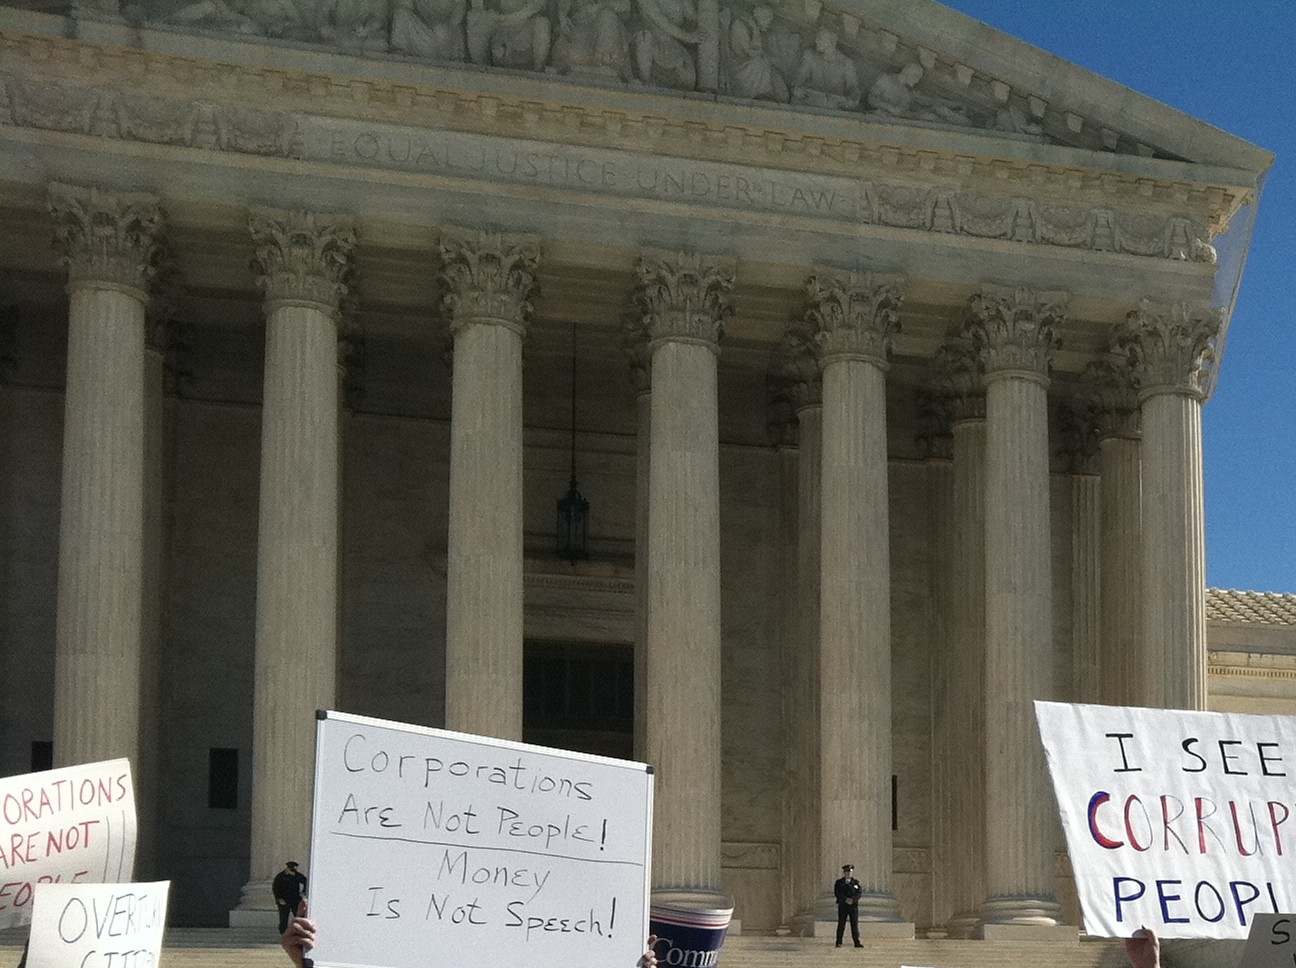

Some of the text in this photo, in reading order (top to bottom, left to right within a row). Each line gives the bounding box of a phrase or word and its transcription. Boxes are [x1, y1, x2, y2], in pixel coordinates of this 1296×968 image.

[331, 133, 837, 210] EQUAL JUSTICE UNDER LAW
[343, 733, 594, 801] Corporations
[1105, 733, 1287, 777] I SEE
[4, 774, 127, 825] ORATIONS
[423, 801, 480, 835] Not
[497, 806, 607, 851] People!
[46, 820, 100, 857] NOT
[437, 849, 550, 904] Money
[366, 886, 617, 942] Is Not Speech!
